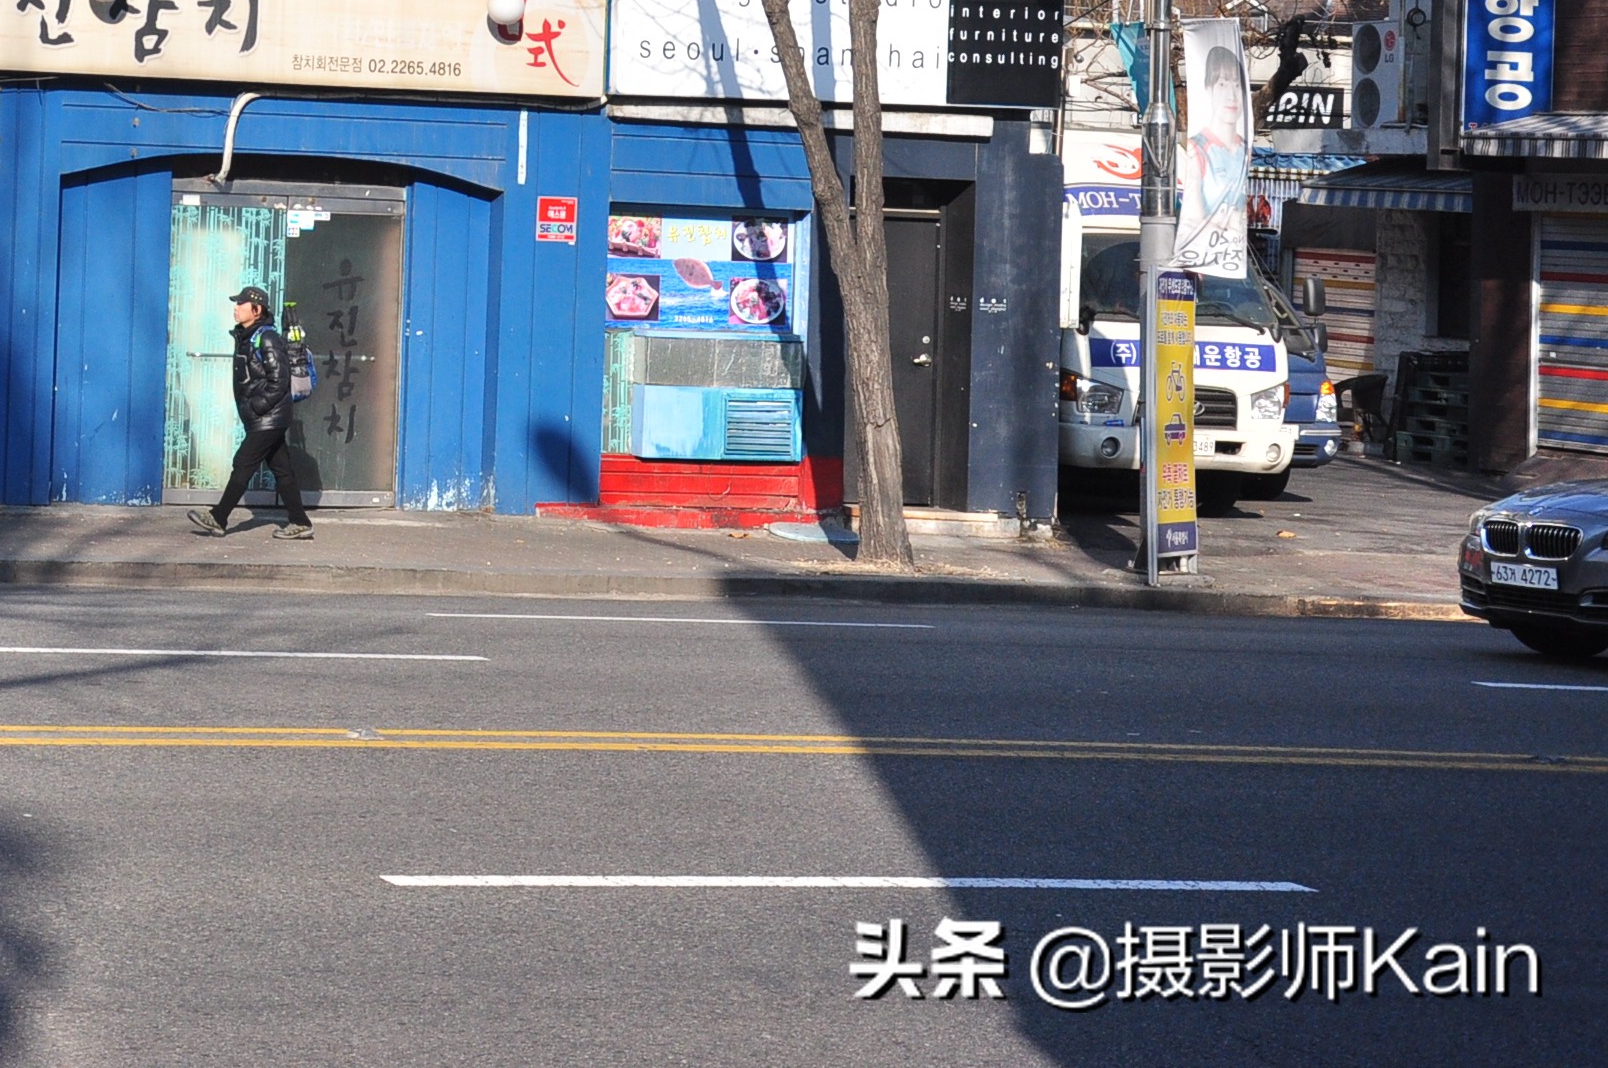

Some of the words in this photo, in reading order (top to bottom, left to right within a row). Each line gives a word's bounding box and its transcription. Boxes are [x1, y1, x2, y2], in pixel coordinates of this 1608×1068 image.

[950, 5, 1059, 21] interior
[949, 28, 1059, 43] furniture
[292, 54, 363, 73] 참치회전문점
[368, 59, 462, 78] 02.2265.4816
[948, 51, 1059, 69] consulting
[1384, 53, 1395, 63] LG
[539, 223, 573, 234] SECOM
[322, 258, 364, 444] 유진참치
[1521, 568, 1551, 586] 4272
